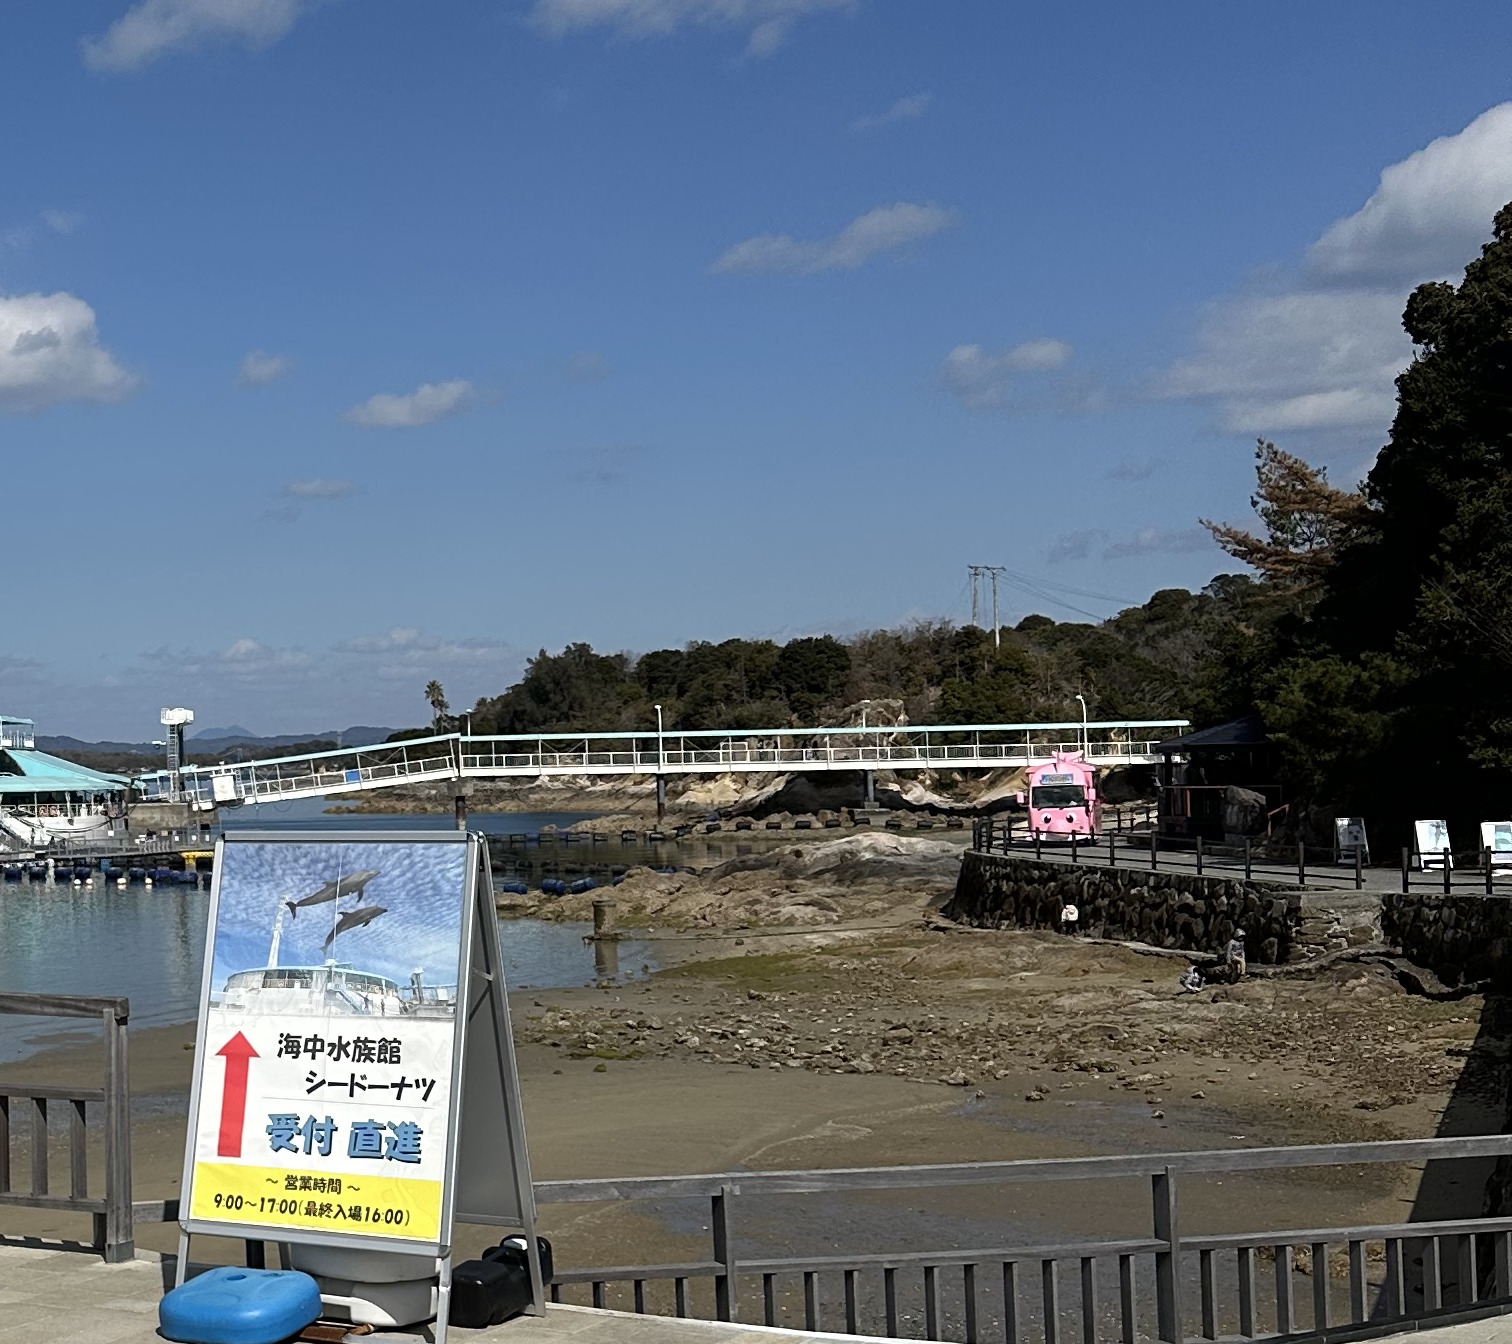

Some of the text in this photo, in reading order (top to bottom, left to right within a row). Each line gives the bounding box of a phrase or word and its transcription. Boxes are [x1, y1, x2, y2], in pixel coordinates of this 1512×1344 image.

[276, 1032, 402, 1065] 海中水族館
[305, 1070, 437, 1102] シードーナツ
[265, 1113, 424, 1164] 受付 直進
